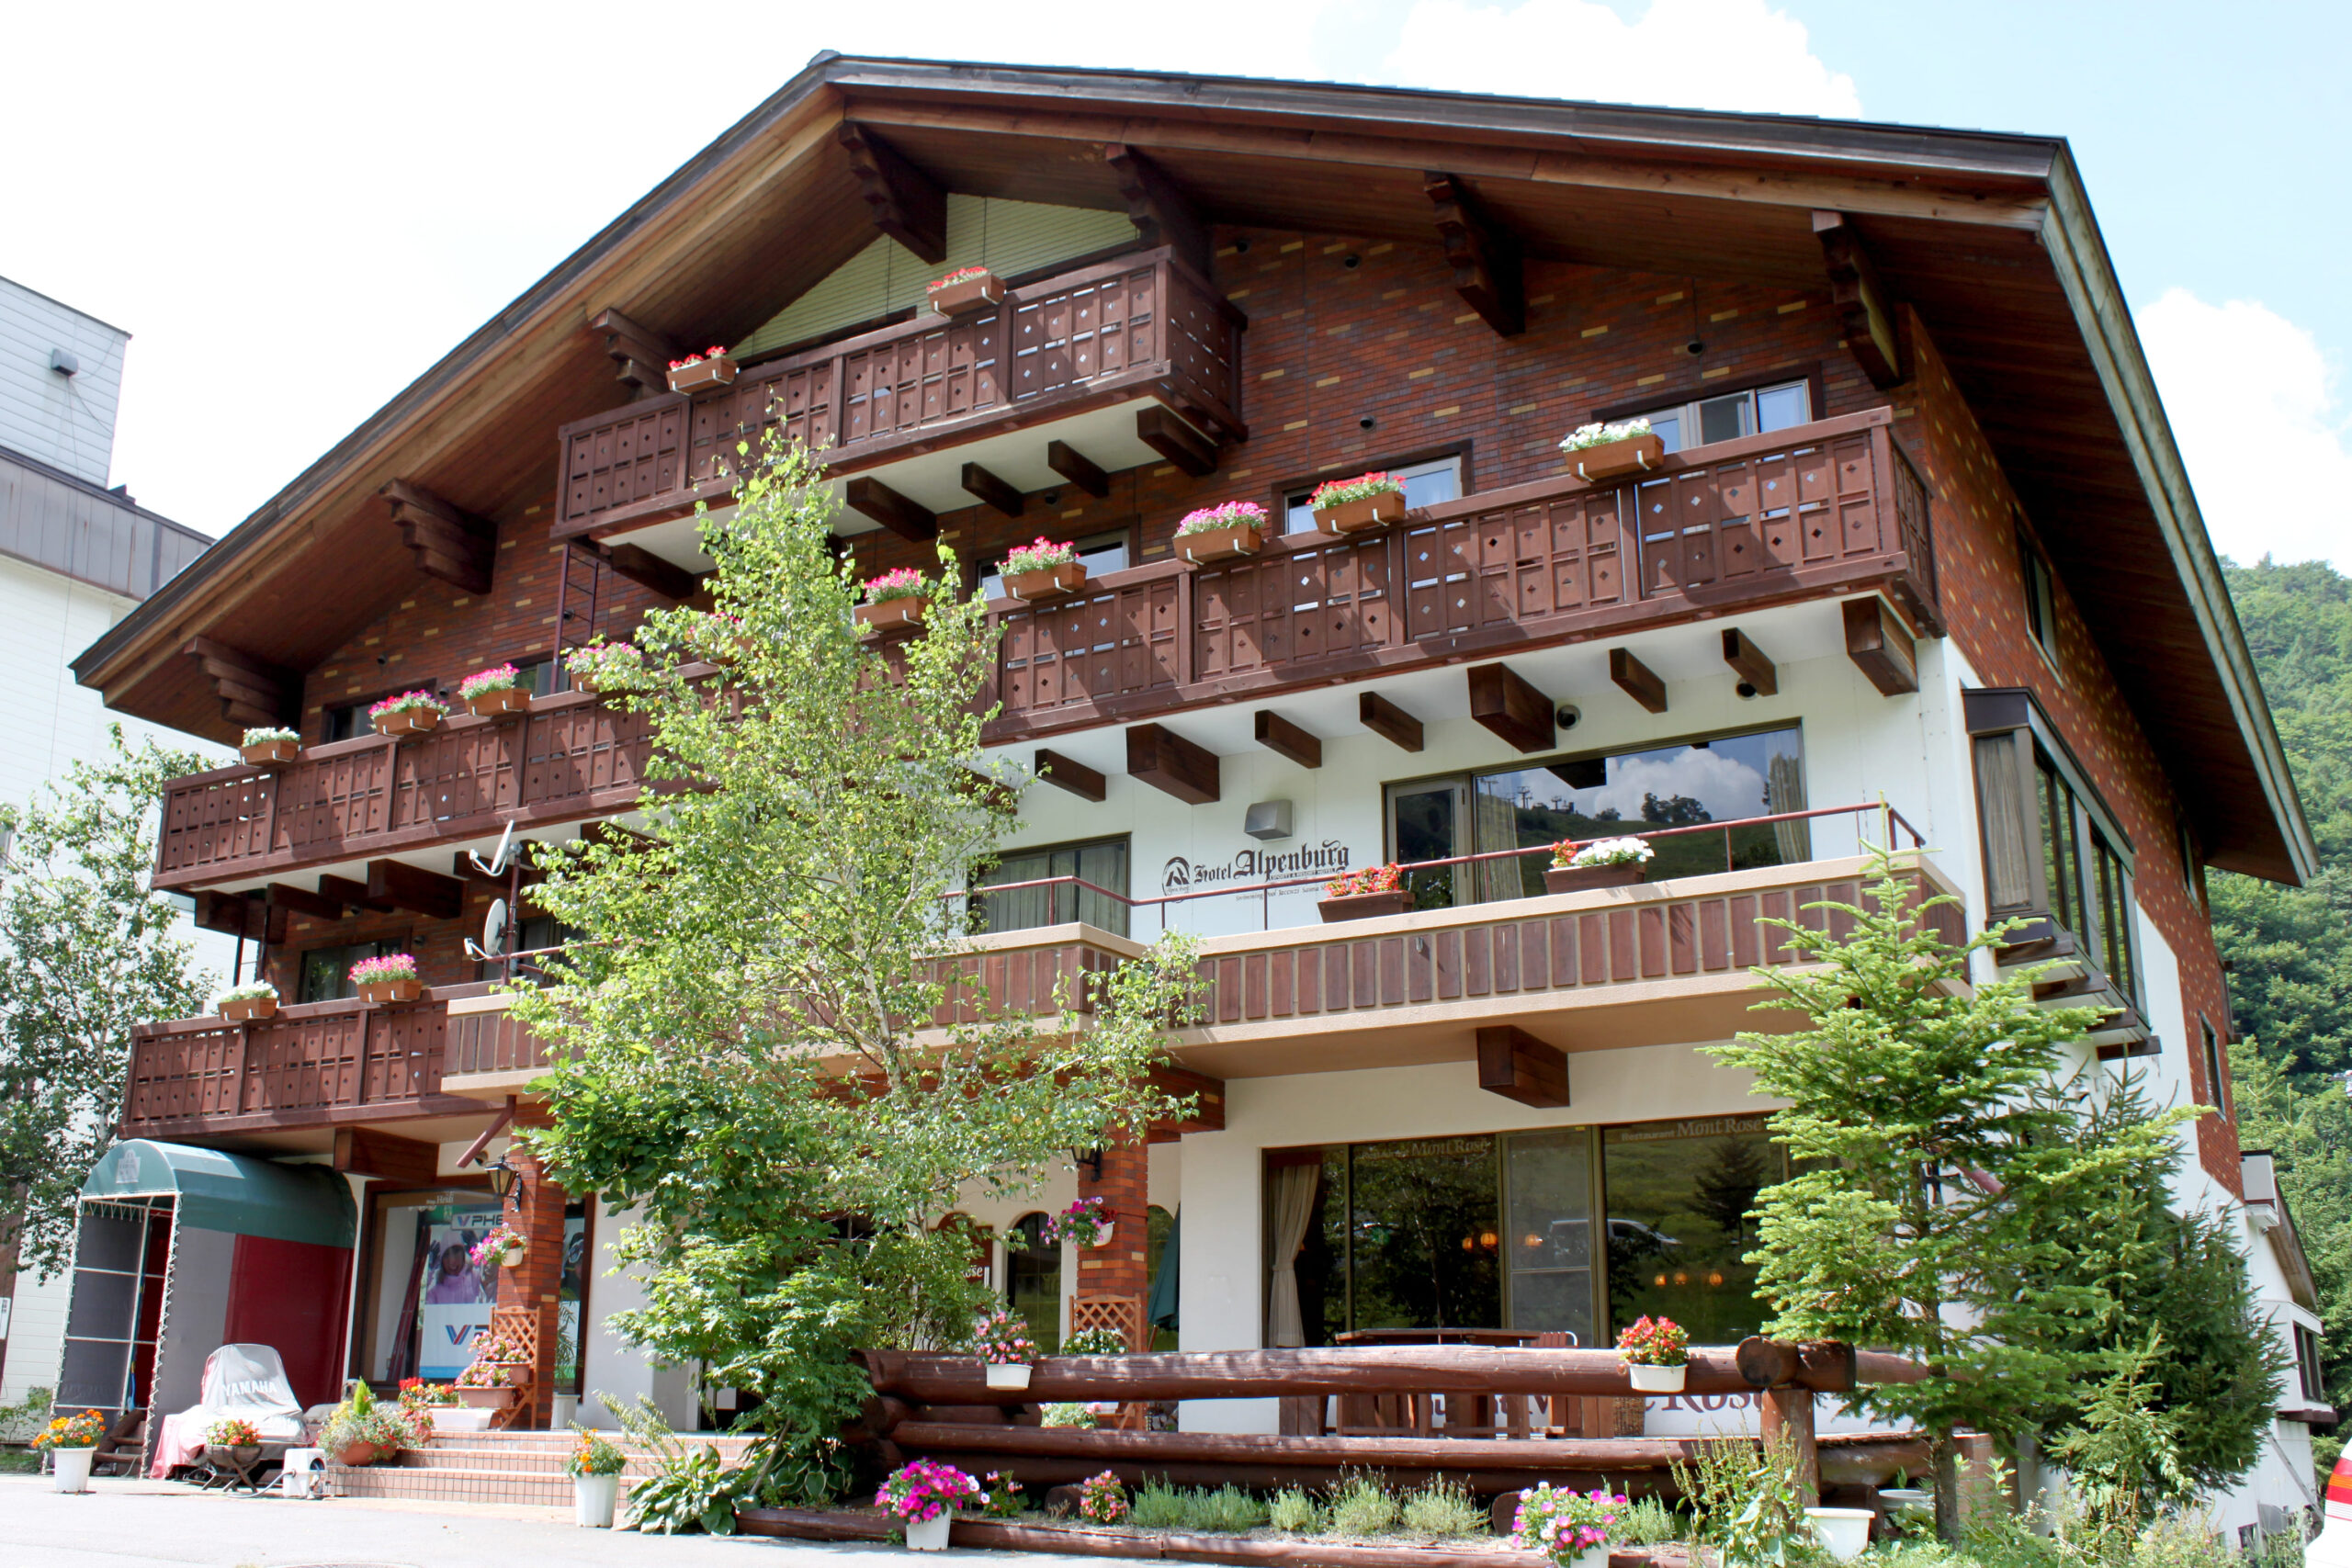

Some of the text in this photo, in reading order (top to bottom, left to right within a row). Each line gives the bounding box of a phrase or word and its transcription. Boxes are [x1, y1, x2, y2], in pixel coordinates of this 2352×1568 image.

[1193, 839, 1350, 885] Hotel Alpenburg
[1621, 1117, 1762, 1142] Restaurant Mont Rose
[1411, 1142, 1452, 1156] Mont
[1454, 1139, 1488, 1154] Rose
[221, 1380, 277, 1397] YAMAHA
